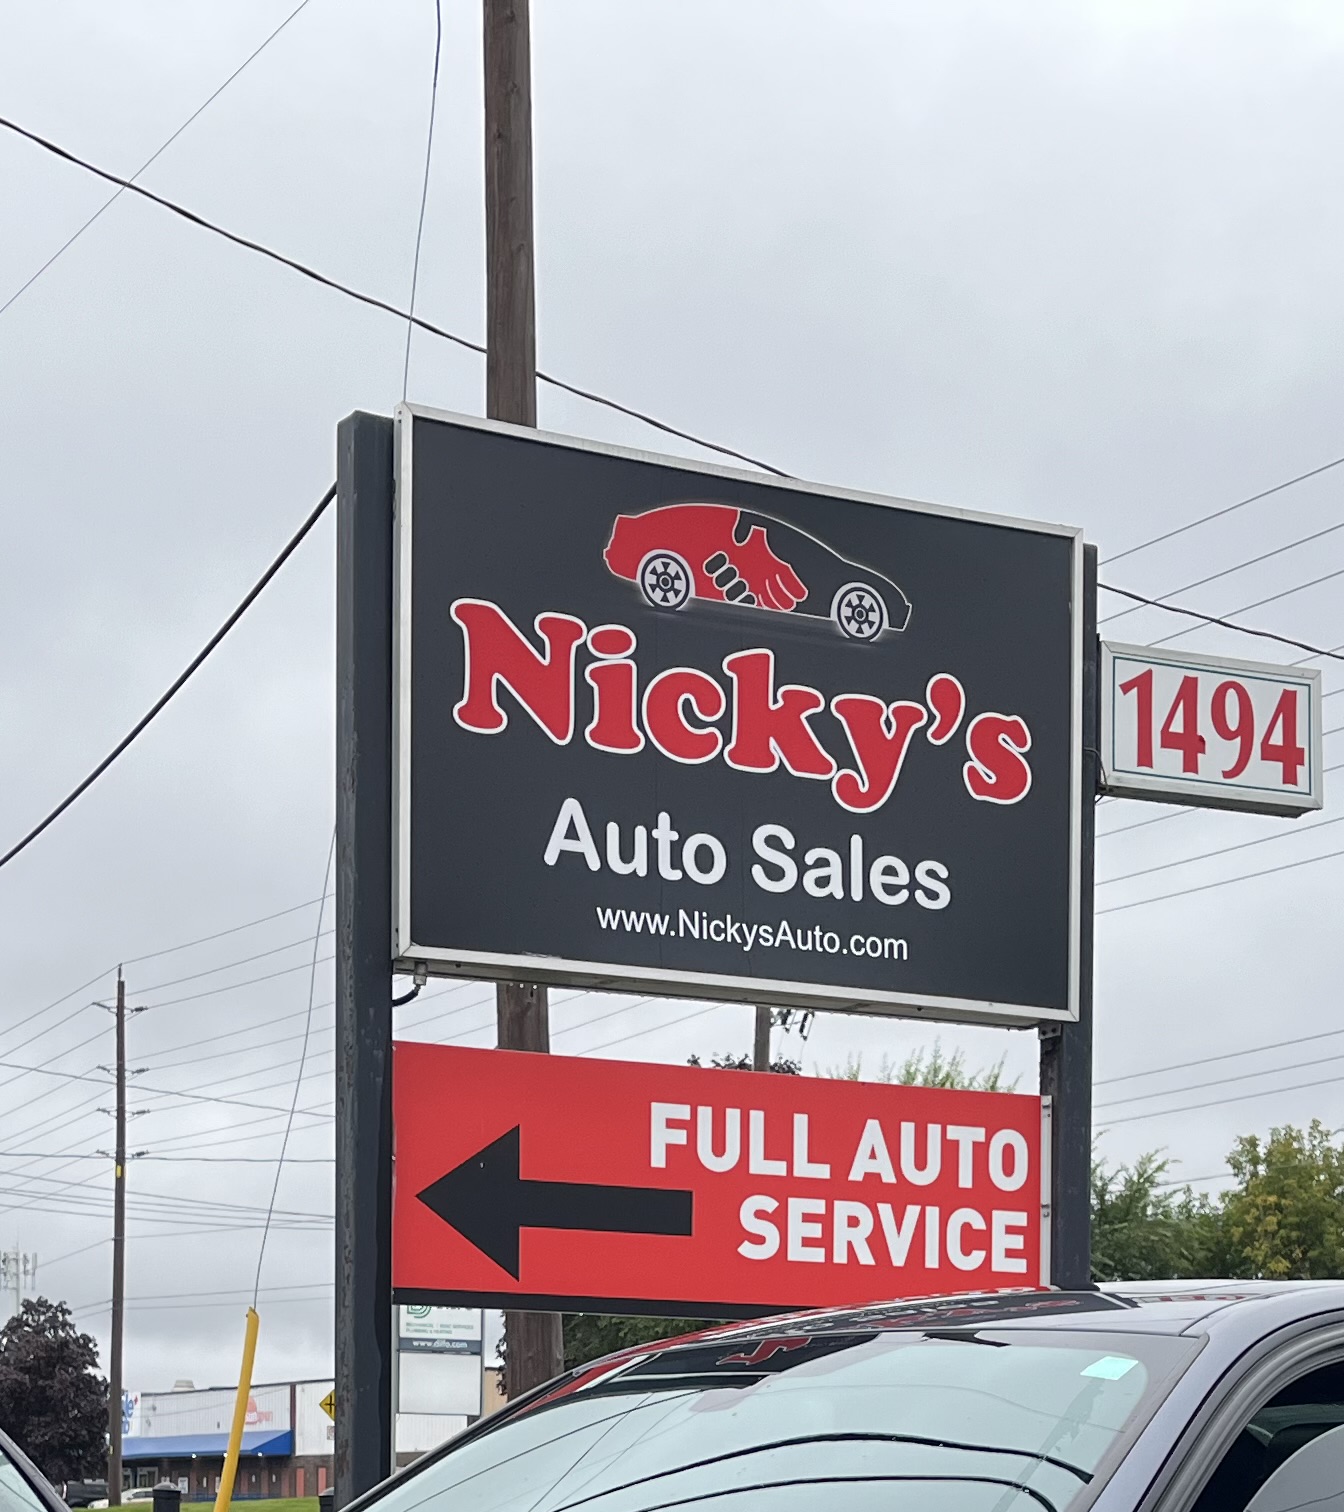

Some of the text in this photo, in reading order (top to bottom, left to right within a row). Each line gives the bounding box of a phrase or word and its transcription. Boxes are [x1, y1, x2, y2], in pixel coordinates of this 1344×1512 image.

[450, 598, 1032, 813] Nicky's
[1120, 669, 1305, 785] 1494
[543, 798, 951, 910] Auto Sales
[596, 906, 908, 961] www.NickysAuto.com
[650, 1102, 1028, 1192] FULL AUTO
[736, 1195, 1028, 1274] SERVICE
